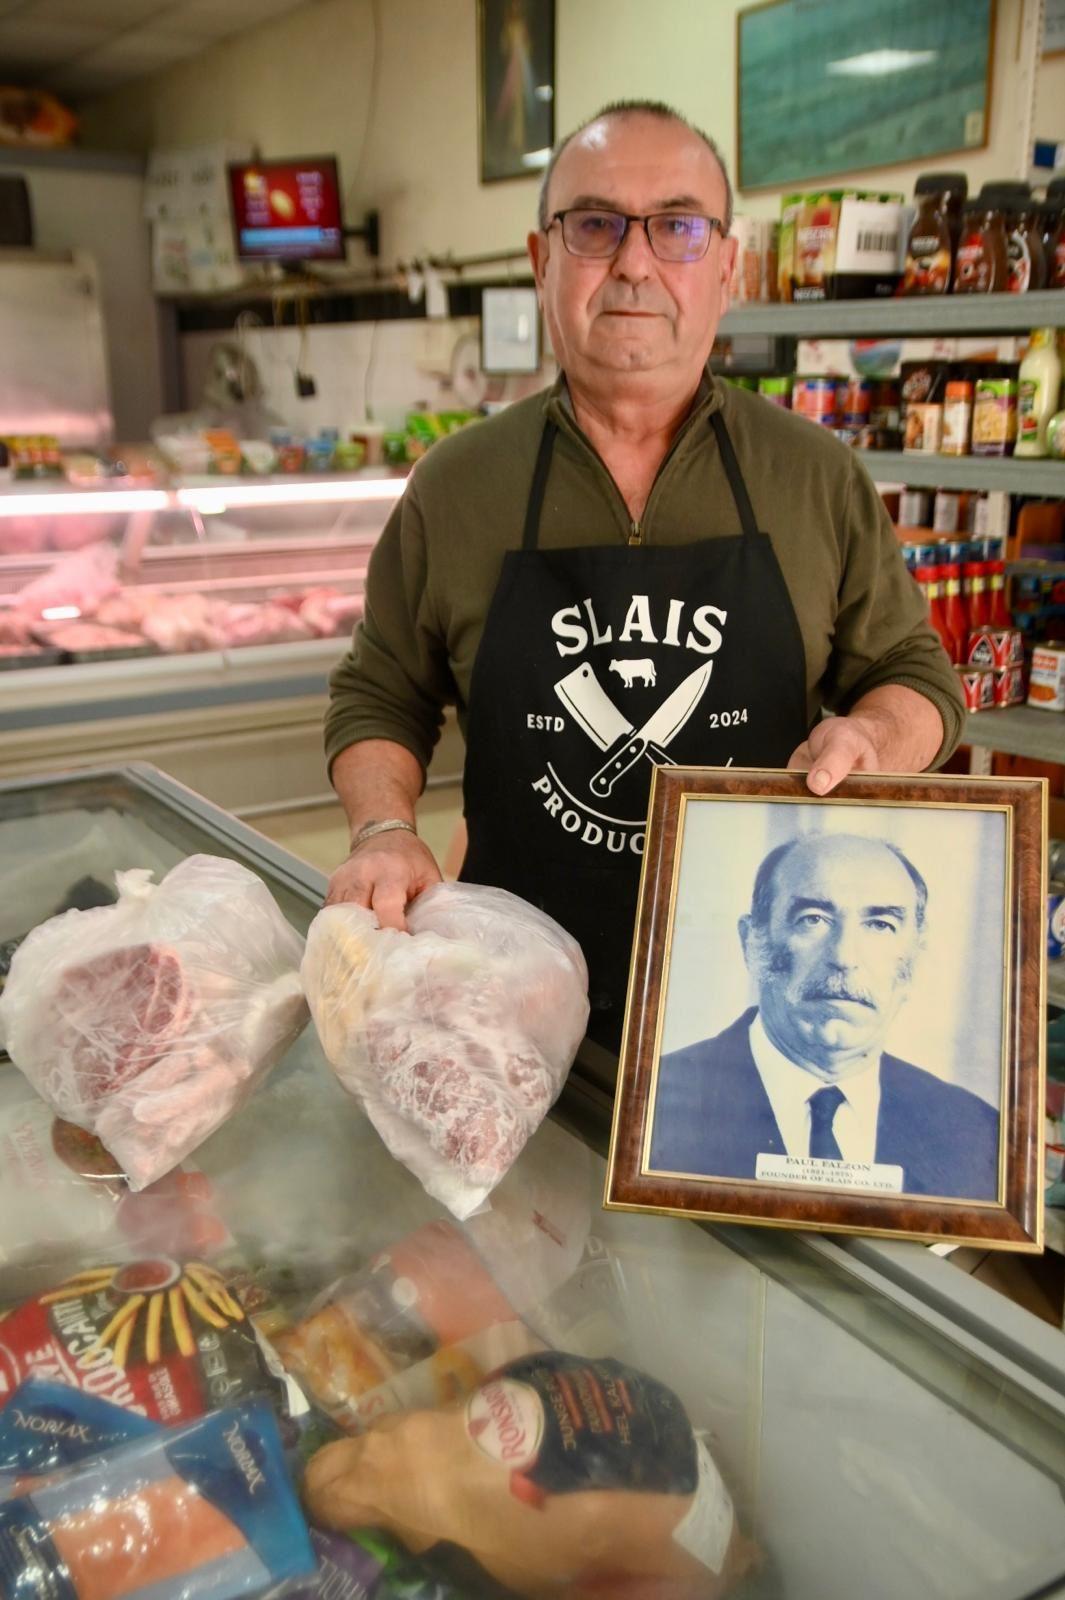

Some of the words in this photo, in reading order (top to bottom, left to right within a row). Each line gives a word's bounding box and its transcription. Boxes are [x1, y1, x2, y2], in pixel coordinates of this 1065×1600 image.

[551, 595, 728, 657] SLAIS
[526, 713, 565, 732] ESTD
[709, 708, 748, 728] 2024
[786, 1156, 818, 1168] PAUL
[821, 1160, 871, 1172] FALZON
[761, 1170, 807, 1180] FOUNDER
